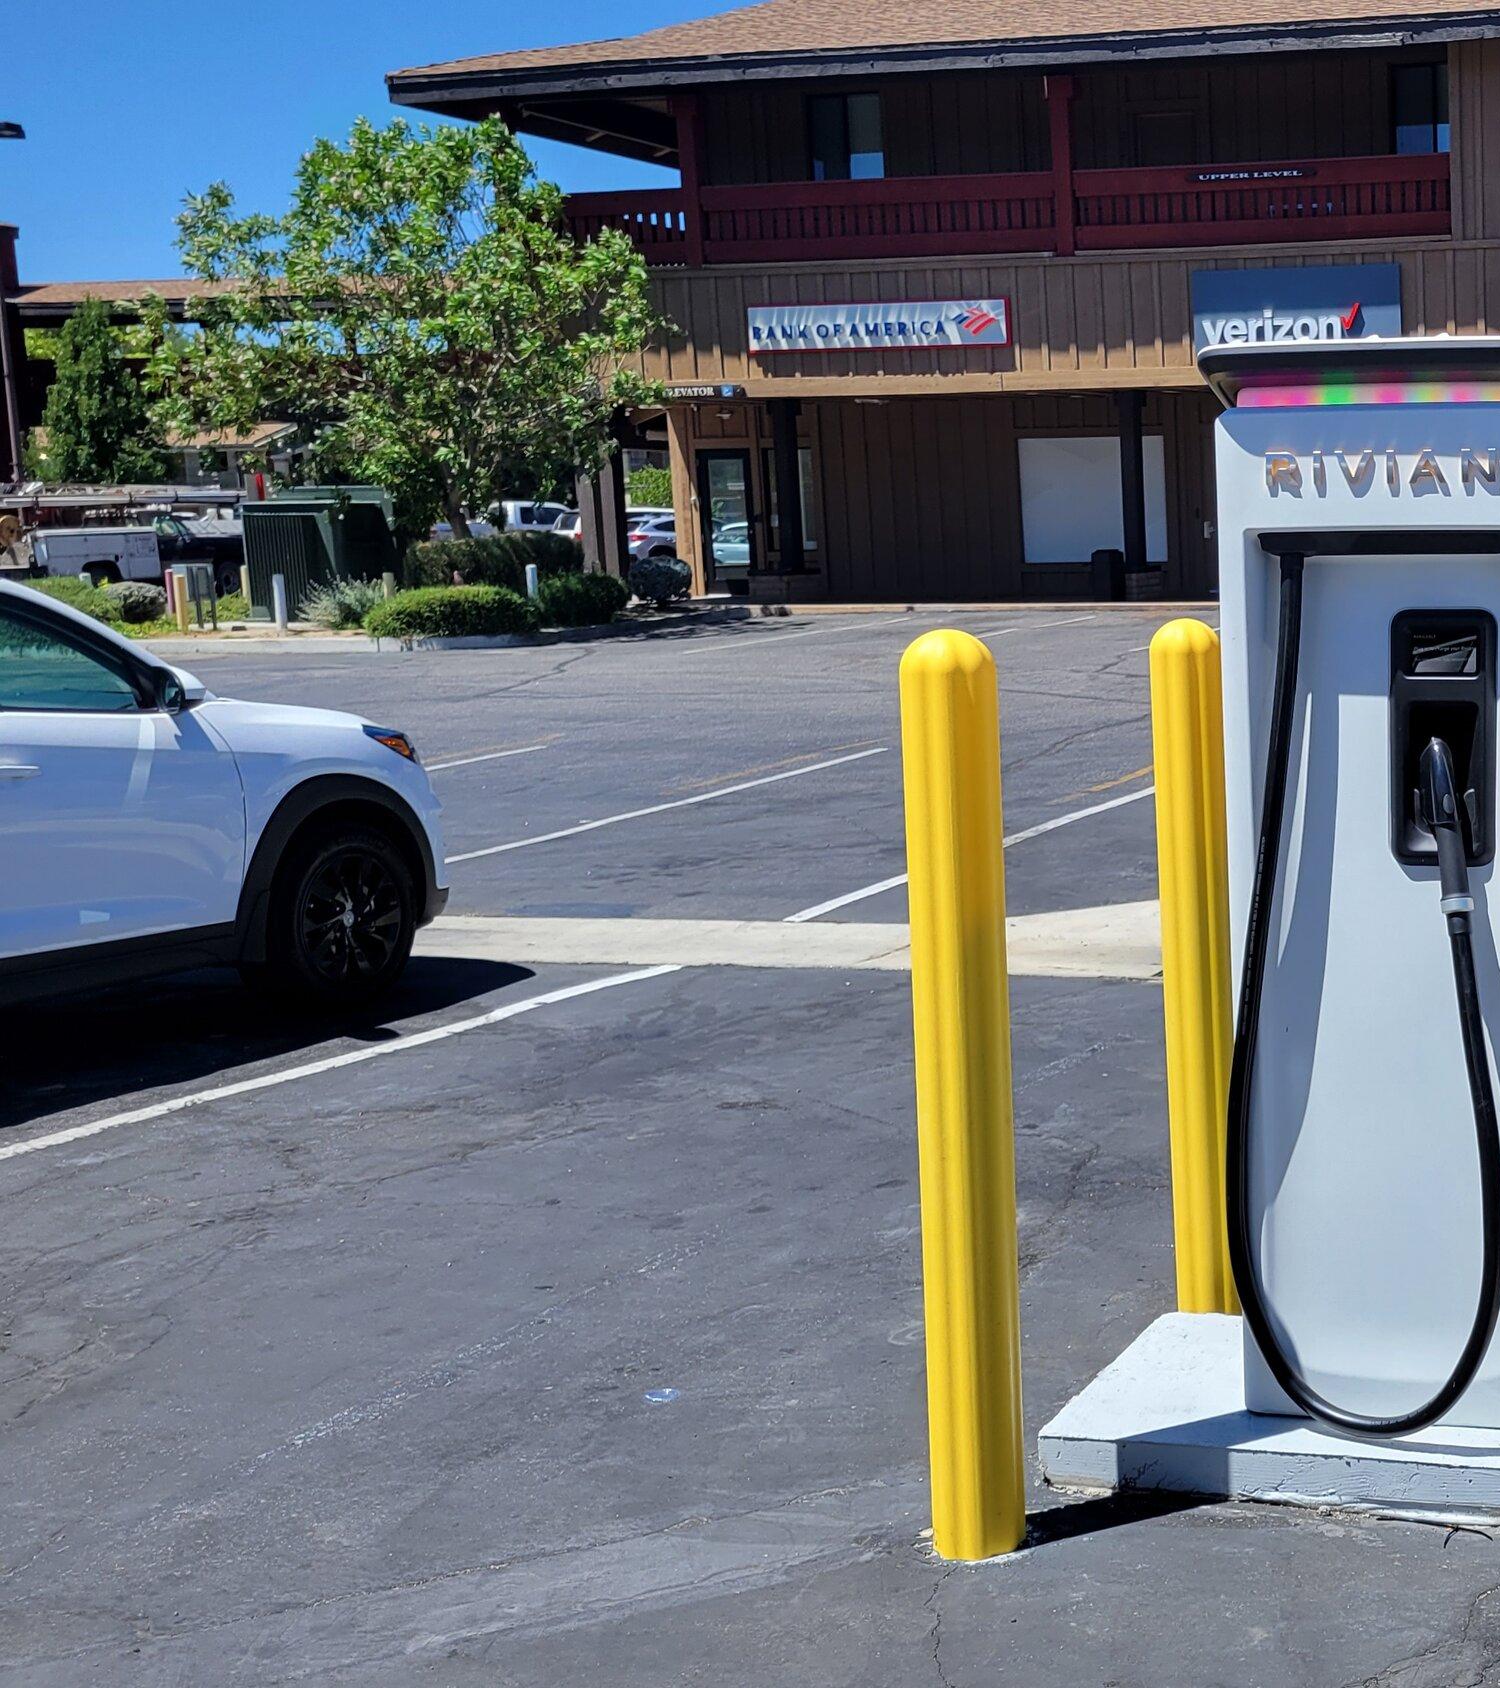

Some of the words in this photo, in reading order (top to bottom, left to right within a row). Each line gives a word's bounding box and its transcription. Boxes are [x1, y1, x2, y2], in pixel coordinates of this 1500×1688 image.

[1199, 172, 1250, 181] UPPER
[1253, 169, 1303, 178] LEVEL
[752, 323, 809, 341] BANK
[816, 323, 842, 339] OF
[849, 319, 946, 338] AMERICA
[1202, 308, 1343, 345] verizon
[1264, 448, 1499, 490] RIVIAN
